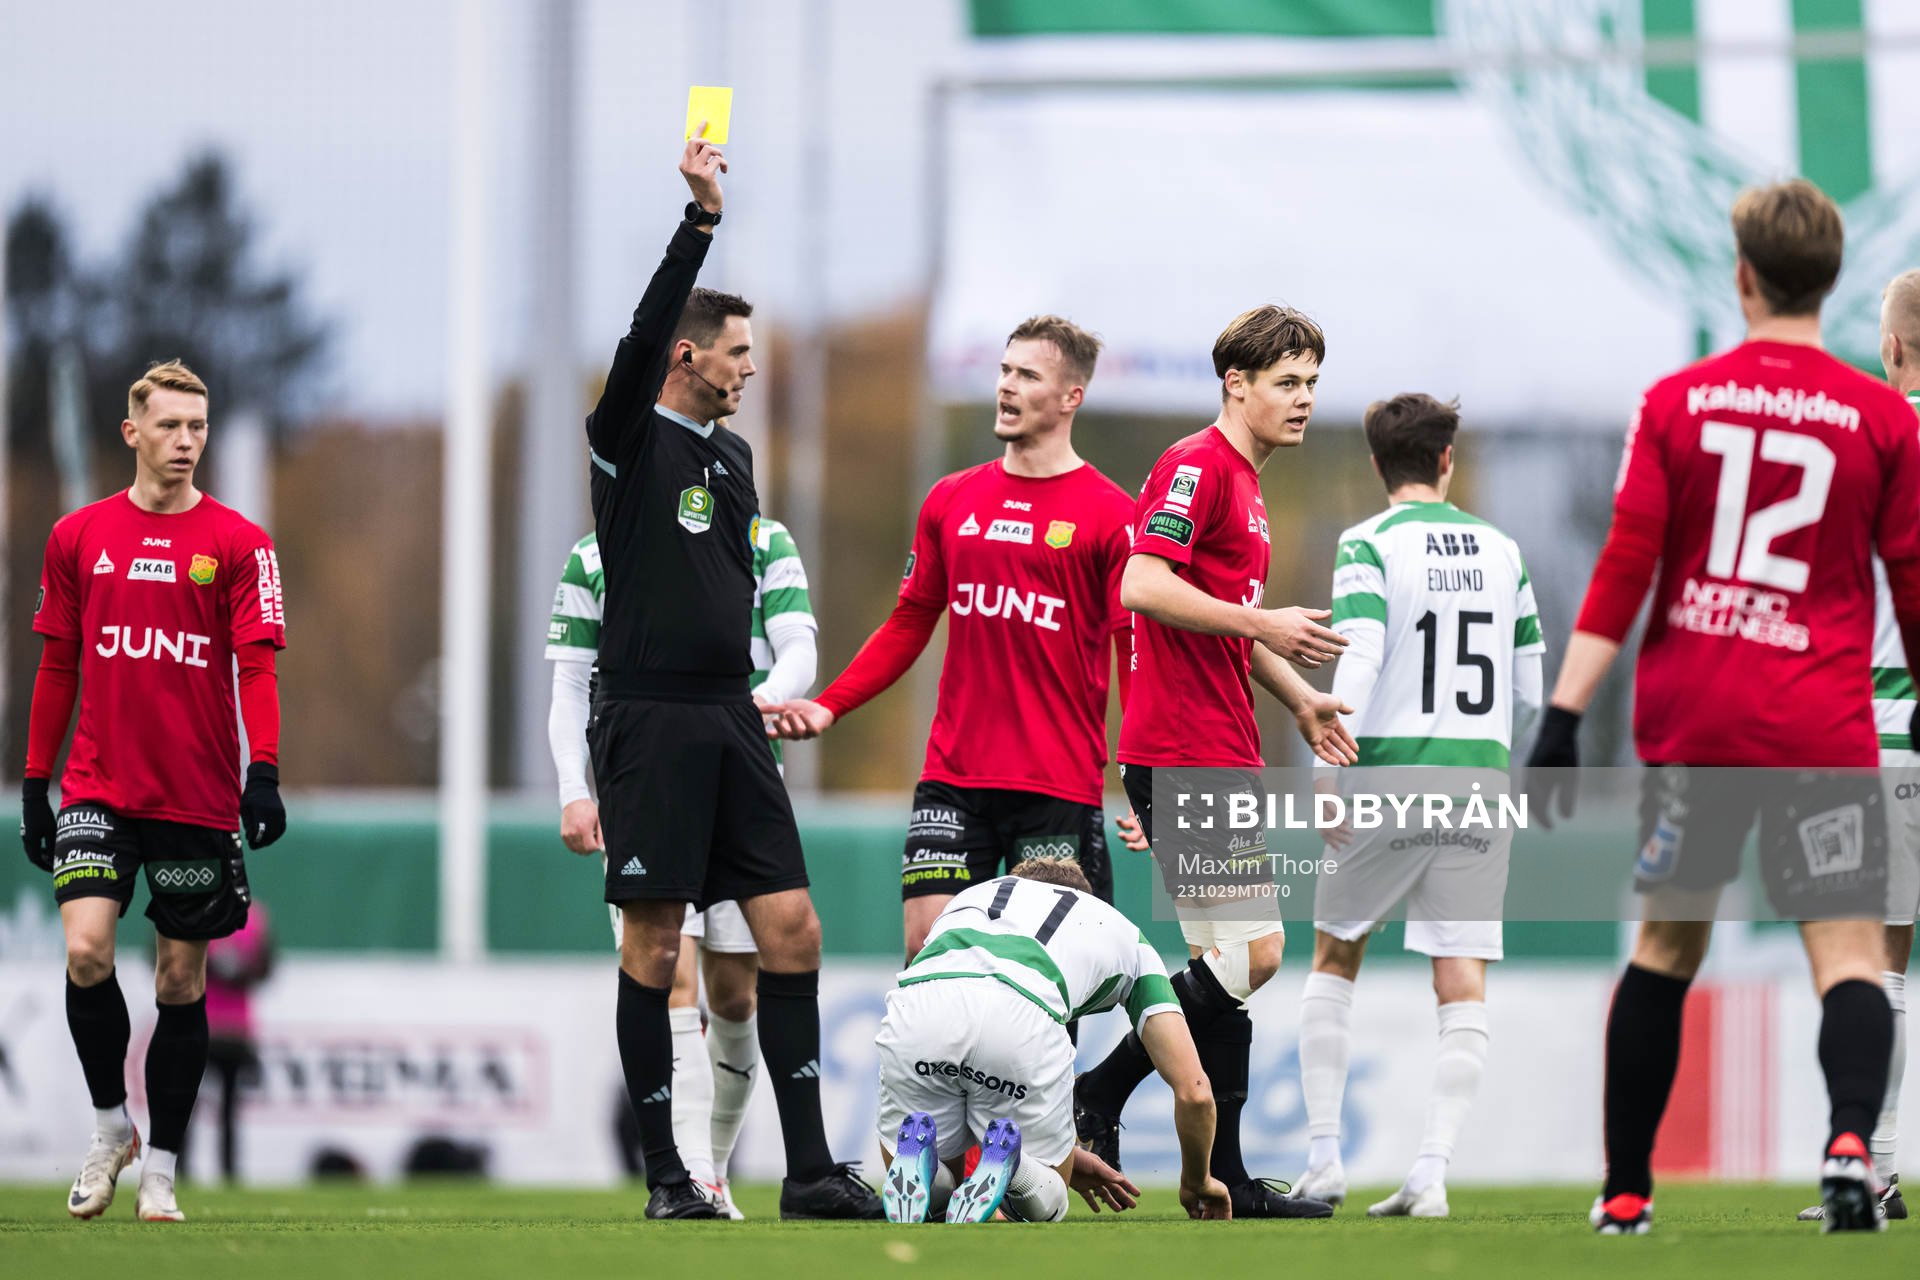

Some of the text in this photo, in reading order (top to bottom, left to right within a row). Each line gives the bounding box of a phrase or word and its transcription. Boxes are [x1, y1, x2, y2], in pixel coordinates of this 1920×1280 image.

[1687, 380, 1860, 432] Kalahöjden
[1002, 499, 1032, 512] JUNI
[1701, 420, 1836, 593] 12
[991, 522, 1031, 538] SKAB
[1151, 516, 1191, 535] UNIBET
[142, 537, 171, 548] JUNI
[1426, 532, 1480, 556] ABB
[133, 561, 173, 574] SKAB
[1428, 568, 1483, 592] EDLUND
[951, 583, 1066, 632] JUNI
[96, 625, 211, 668] JUNI
[1415, 609, 1495, 716] 15
[1389, 828, 1491, 855] axelssons
[103, 867, 118, 880] AB
[954, 867, 971, 881] AB
[989, 876, 1080, 946] 11
[915, 1061, 1028, 1100] axelssons
